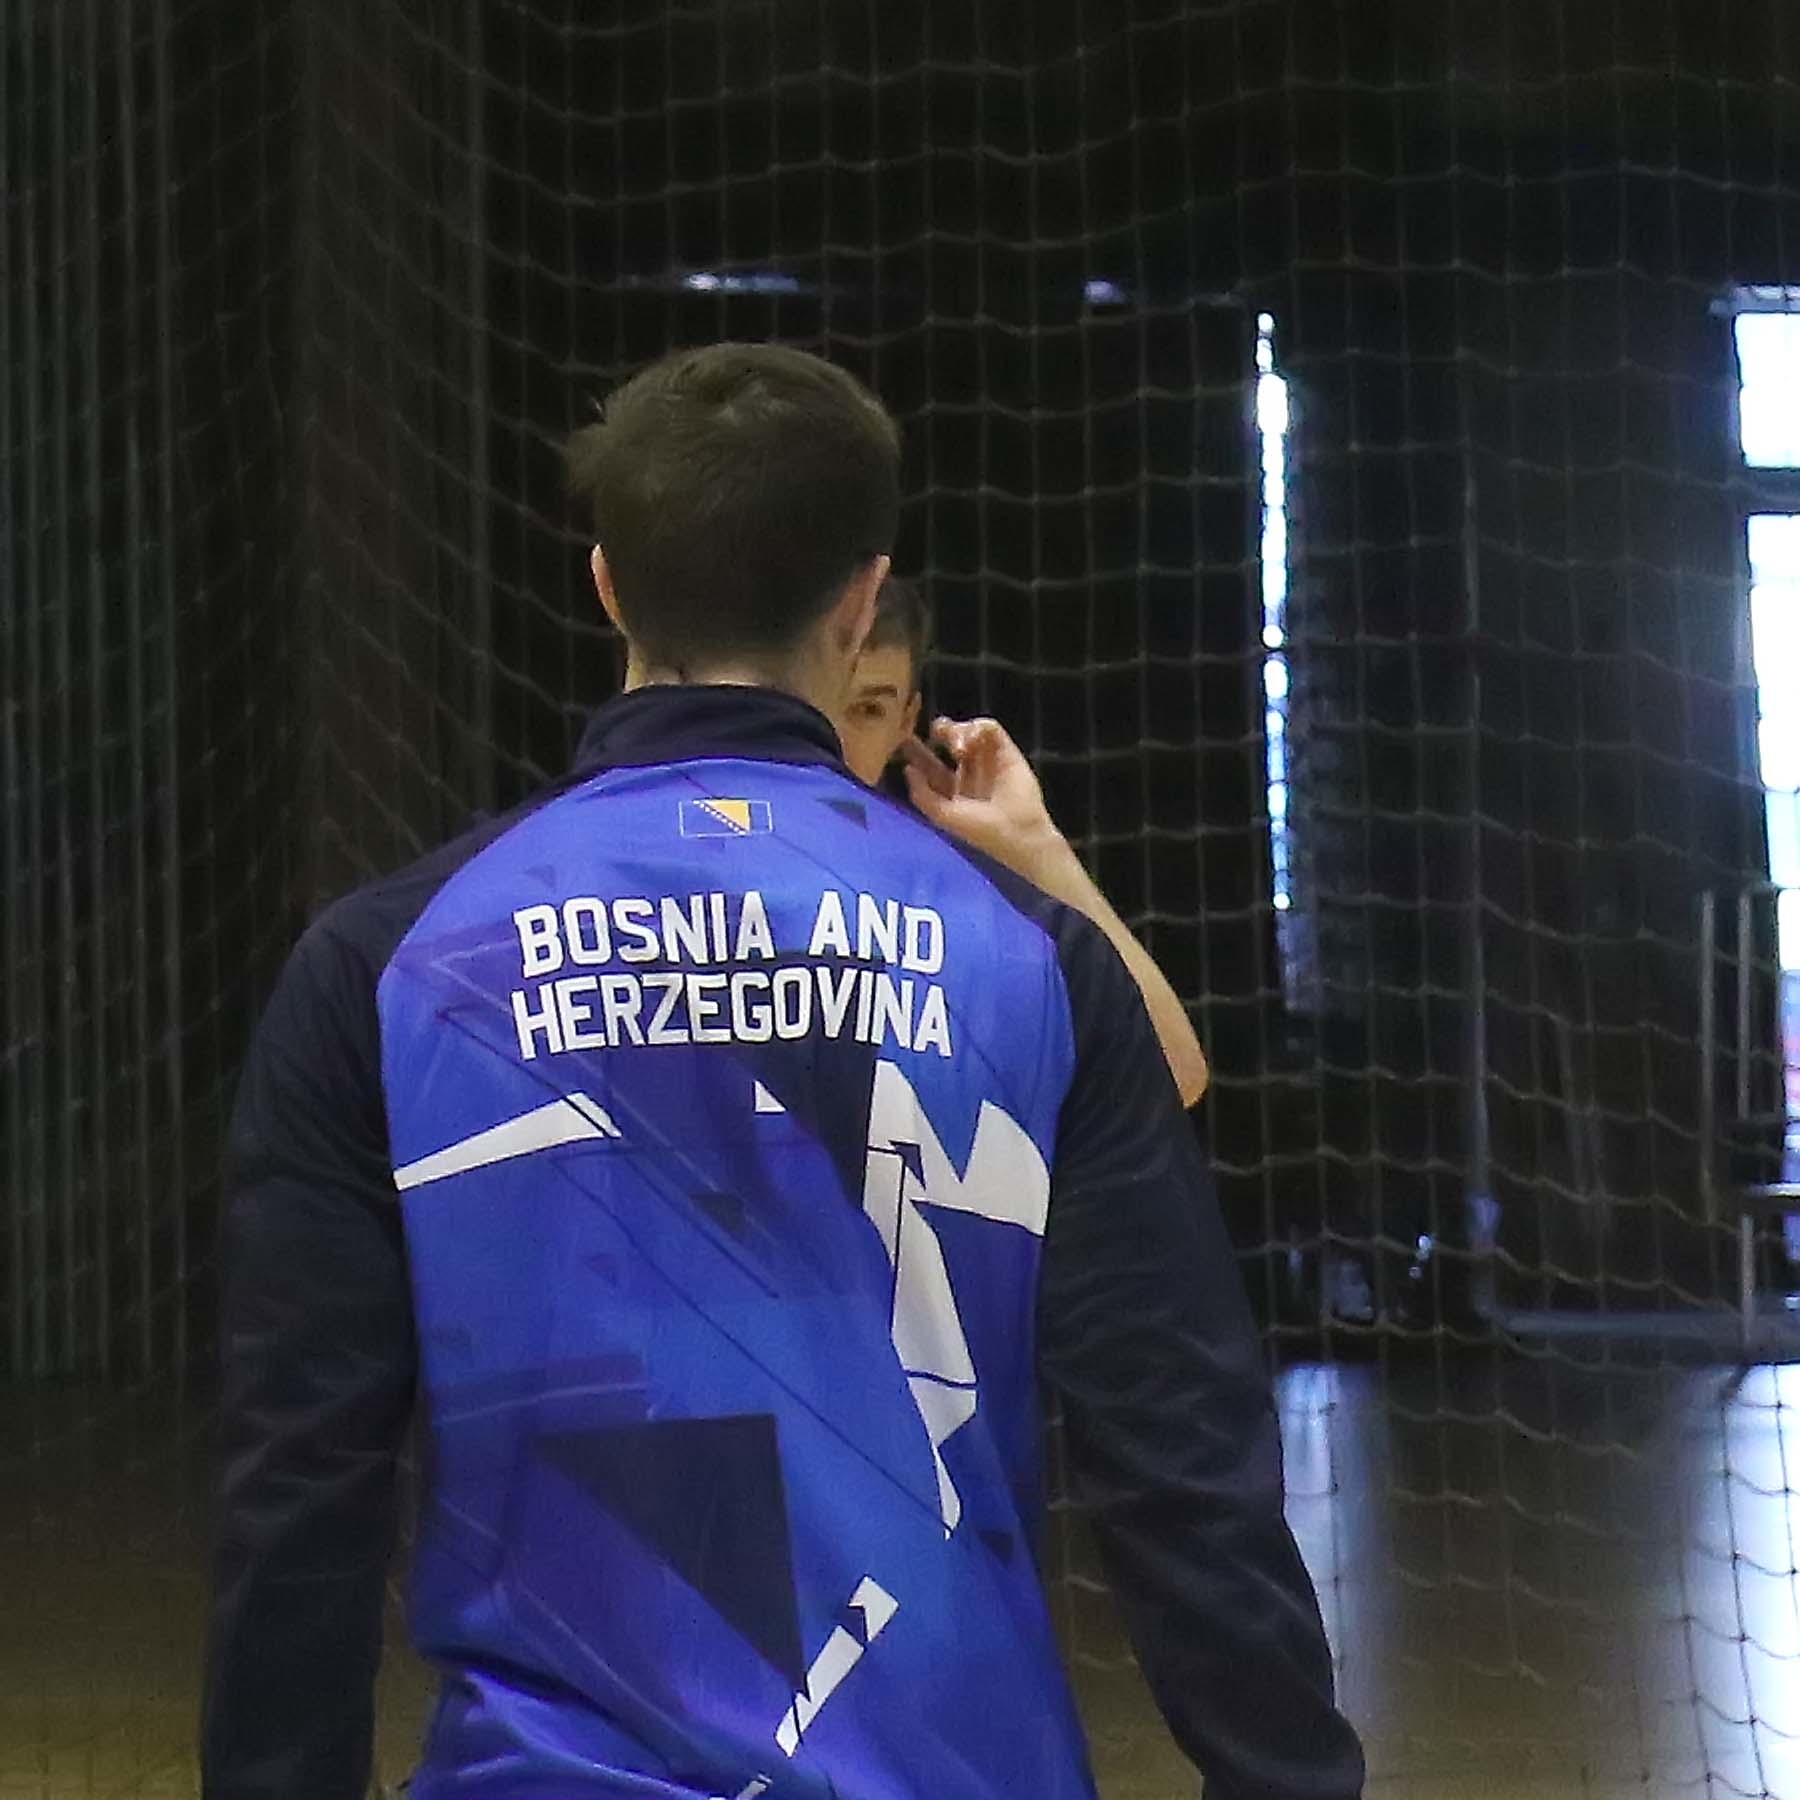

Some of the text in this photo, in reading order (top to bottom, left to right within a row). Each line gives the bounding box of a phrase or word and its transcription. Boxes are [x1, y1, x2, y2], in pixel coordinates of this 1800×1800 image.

[512, 889, 946, 979] BOSNIA AND
[510, 966, 953, 1061] HERZEGOVINA
